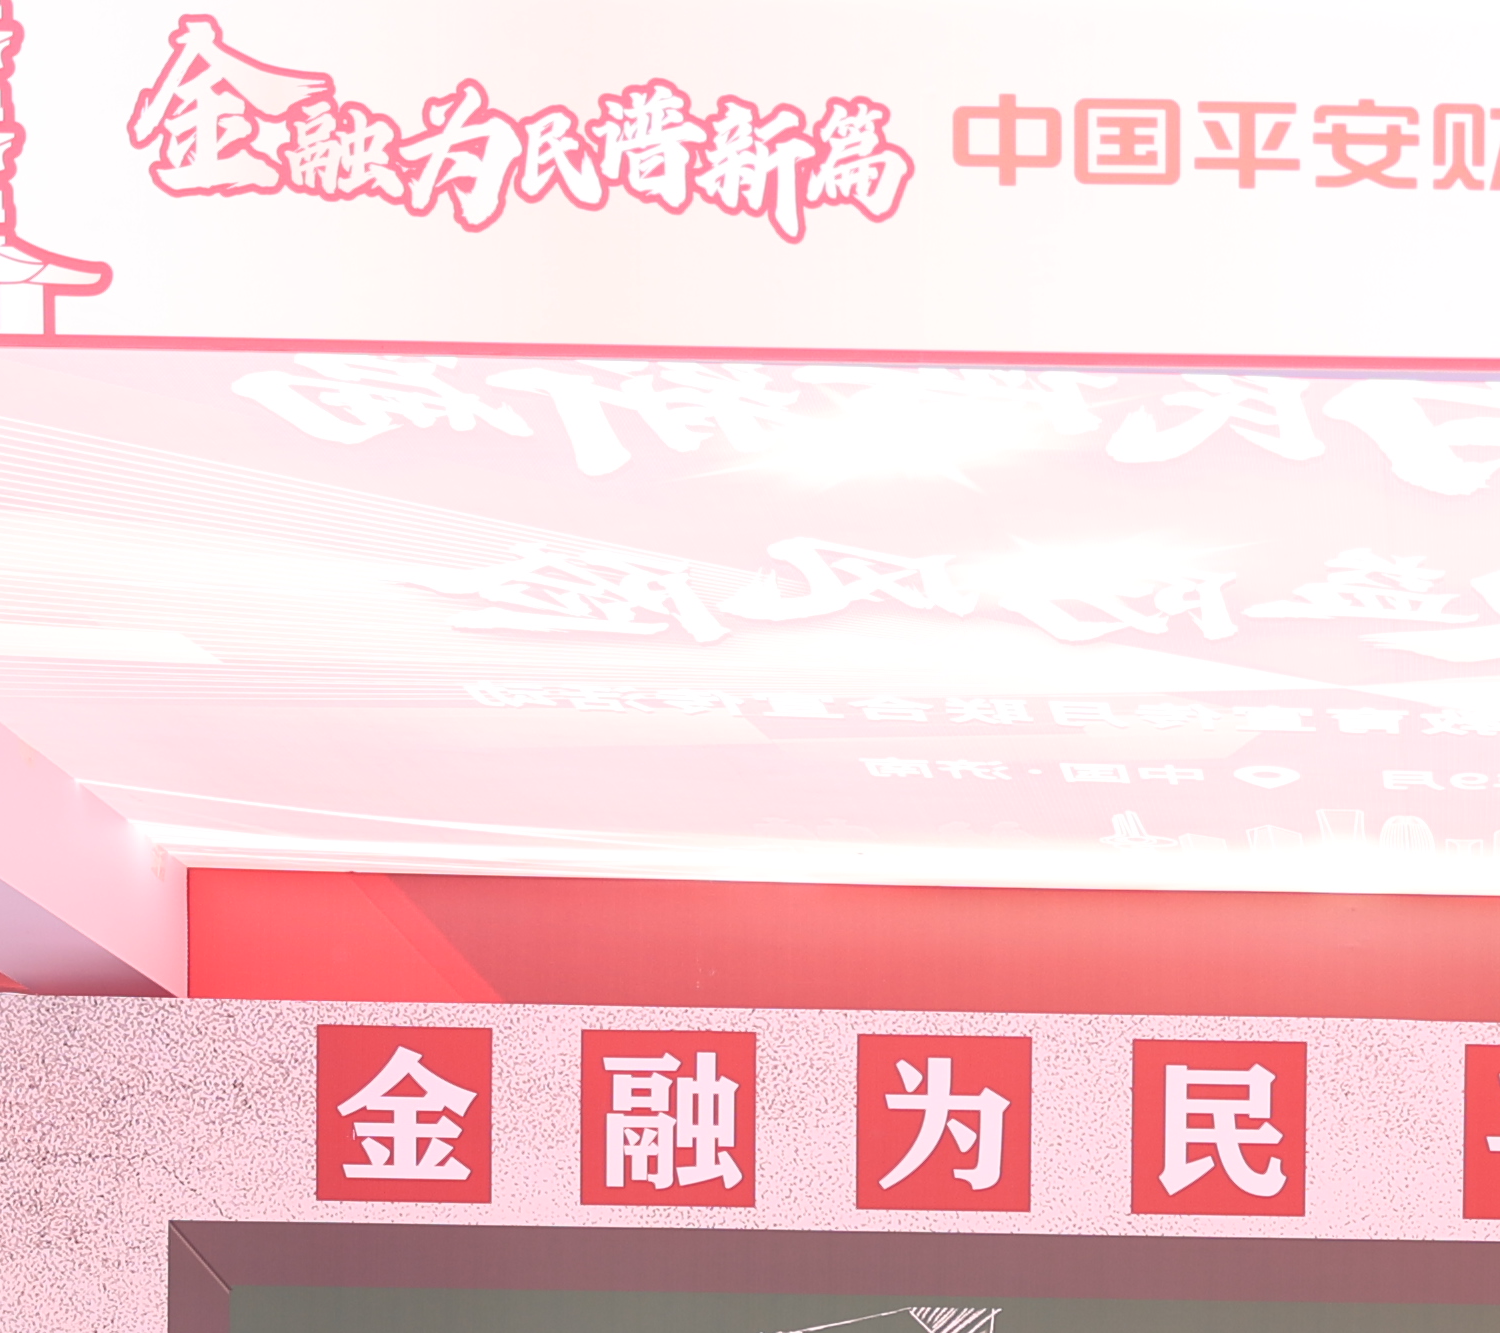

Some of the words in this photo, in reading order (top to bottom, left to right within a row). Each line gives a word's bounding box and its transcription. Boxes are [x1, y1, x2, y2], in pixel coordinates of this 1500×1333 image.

[127, 14, 915, 242] 金融为民谱新篇
[337, 1045, 1288, 1197] 金融为民
